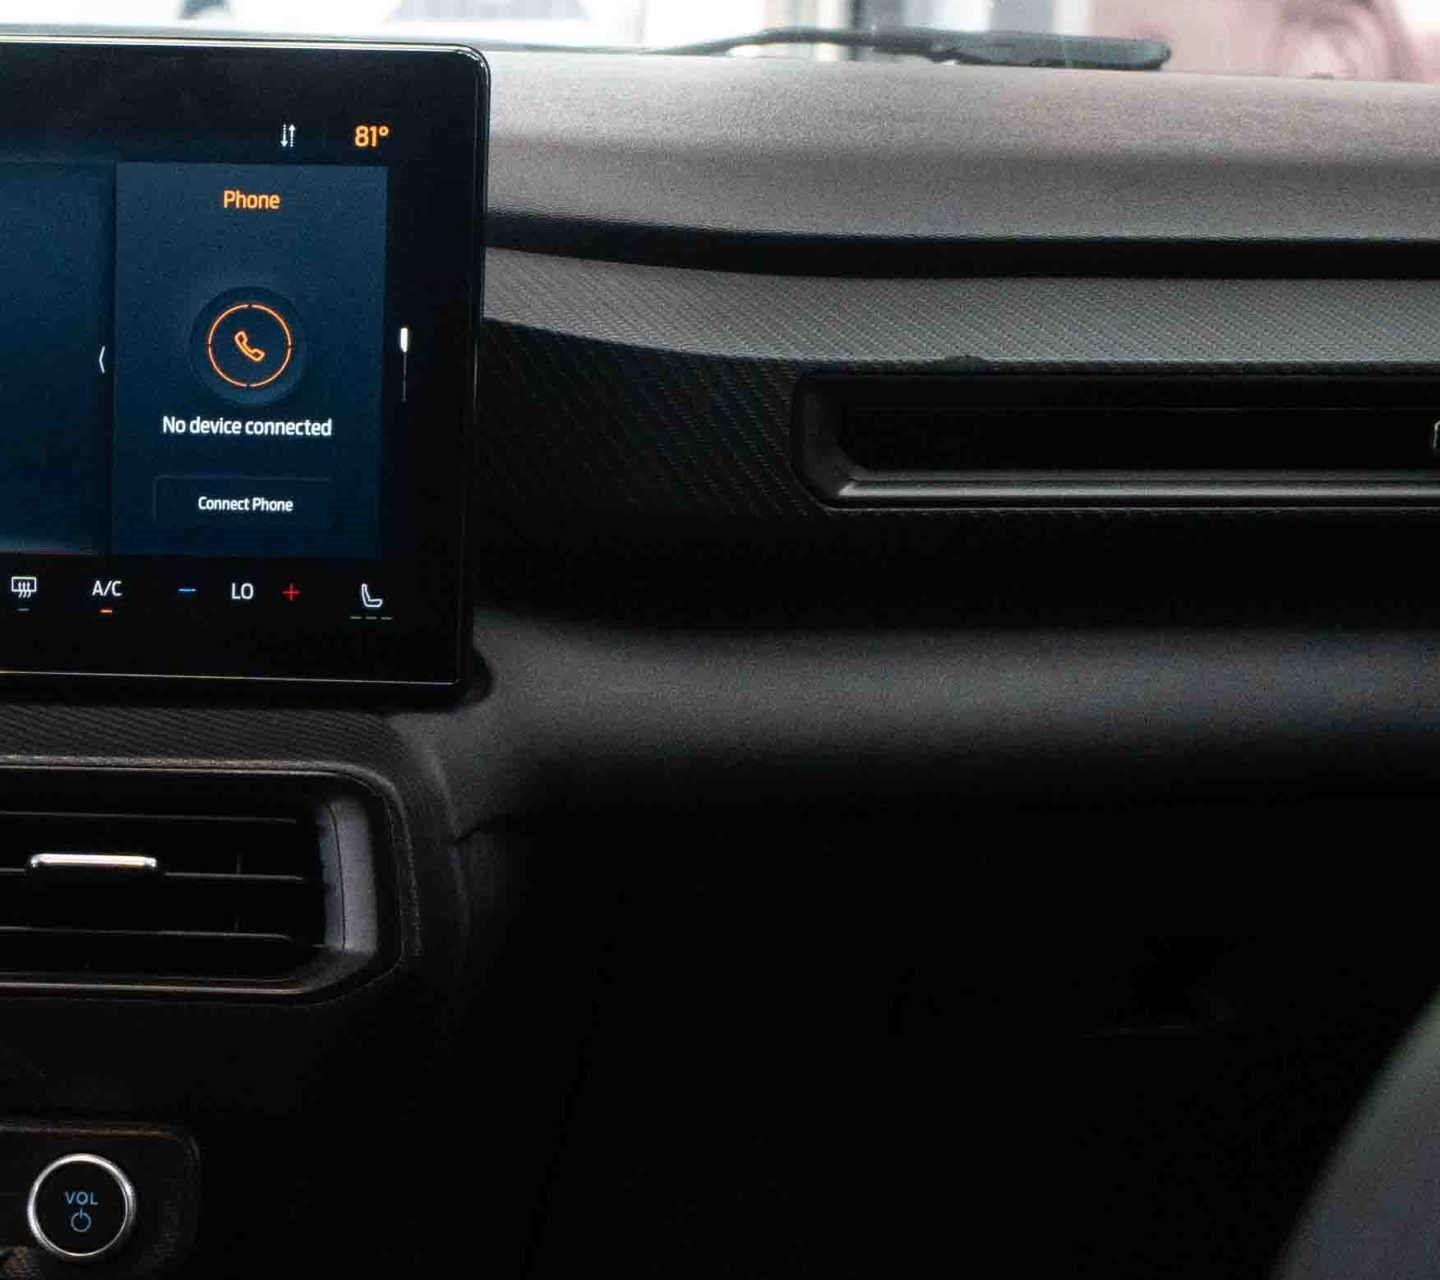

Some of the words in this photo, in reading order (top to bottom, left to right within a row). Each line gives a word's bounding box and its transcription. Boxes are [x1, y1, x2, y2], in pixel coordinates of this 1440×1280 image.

[354, 125, 390, 147] 81°
[223, 189, 281, 210] Phone
[162, 415, 187, 434] No
[189, 415, 243, 435] device
[244, 418, 333, 437] connected
[197, 495, 251, 512] Connect
[252, 496, 294, 513] Phone
[91, 579, 122, 597] A/C
[231, 582, 254, 600] LO
[65, 1191, 99, 1206] VOL
